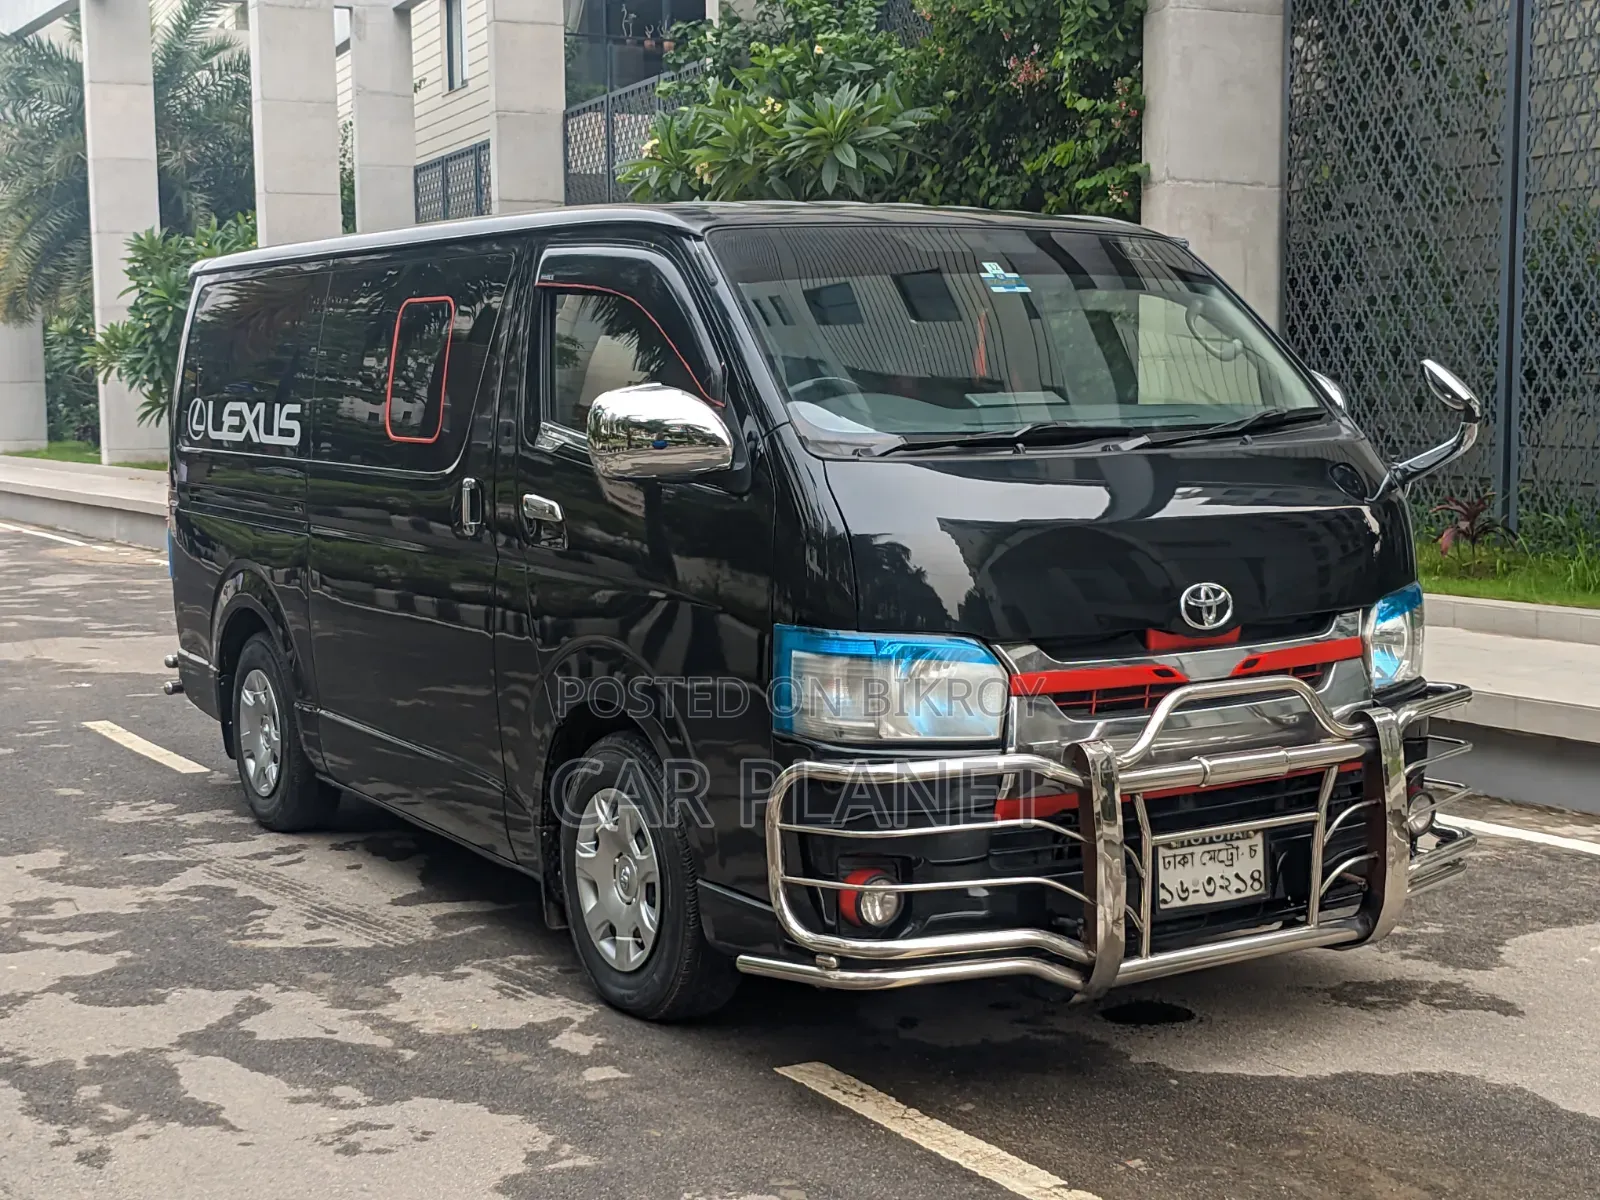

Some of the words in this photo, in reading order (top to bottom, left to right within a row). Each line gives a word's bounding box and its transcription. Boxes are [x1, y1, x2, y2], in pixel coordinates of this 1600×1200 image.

[207, 400, 301, 446] LEXUS
[1162, 852, 1195, 870] ঢাকা
[1160, 869, 1263, 904] ১৬-৩২১৪
